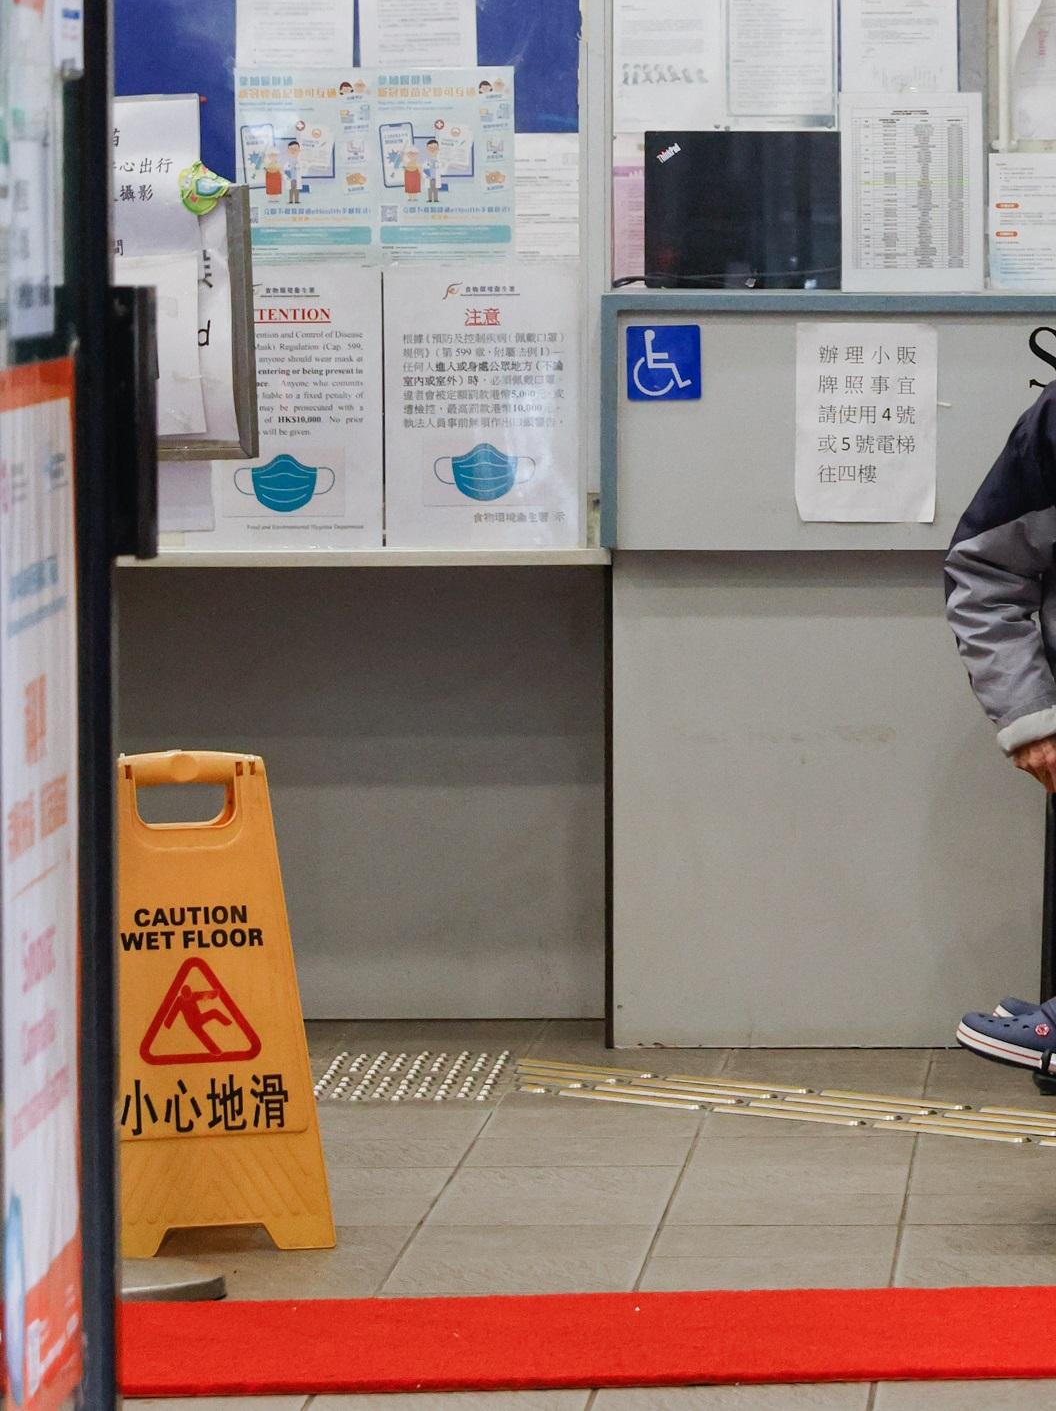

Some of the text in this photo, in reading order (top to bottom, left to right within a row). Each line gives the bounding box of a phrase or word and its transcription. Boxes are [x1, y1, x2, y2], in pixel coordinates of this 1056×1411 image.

[113, 157, 173, 175] 心出行
[113, 184, 154, 202] 攝影
[254, 308, 331, 321] TENTION
[464, 308, 501, 325] 注意
[818, 345, 917, 365] 辦理小販
[818, 375, 916, 396] 牌照事宜
[818, 464, 878, 484] 往四樓
[134, 905, 248, 927] CAUTION
[120, 928, 264, 951] WET FLOOR
[119, 1073, 289, 1136] 小心地滑
